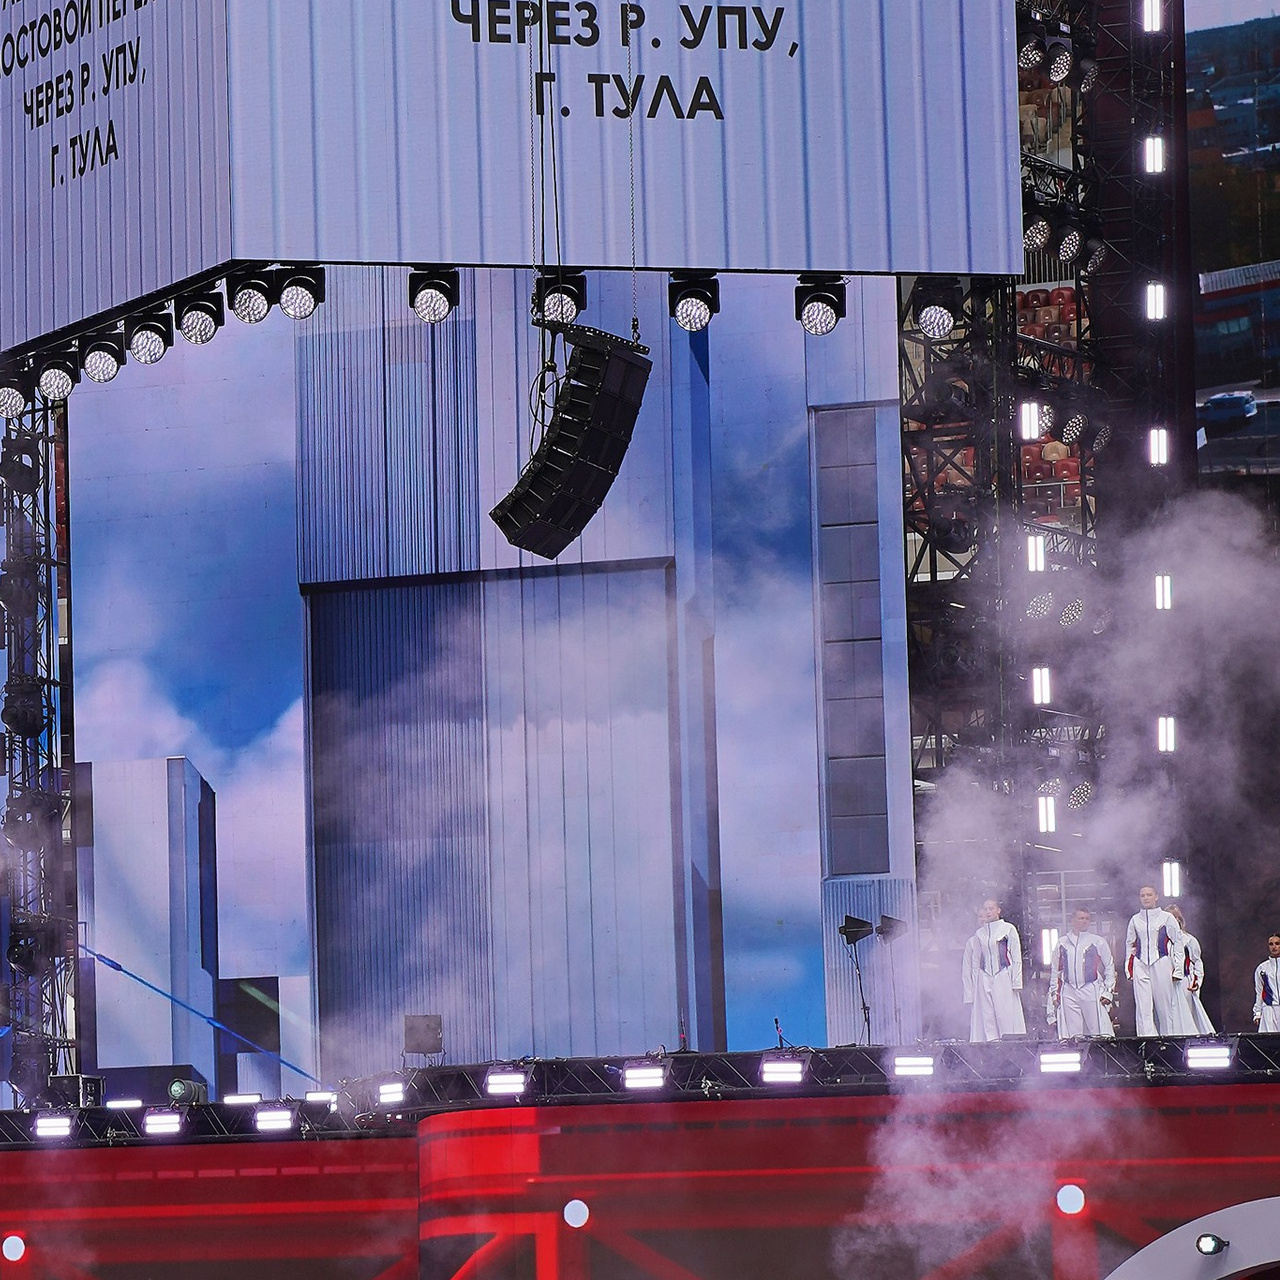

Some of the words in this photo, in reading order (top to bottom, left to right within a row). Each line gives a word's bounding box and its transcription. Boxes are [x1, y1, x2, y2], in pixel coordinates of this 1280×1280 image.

[620, 3, 661, 48] Р.
[679, 4, 799, 58] УПУ,
[24, 69, 74, 130] ЧЕРЕЗ
[81, 62, 96, 106] Р.
[102, 36, 147, 97] УПУ,
[535, 72, 571, 118] Г.
[587, 73, 725, 120] ТУЛА
[51, 145, 64, 189] Г.
[70, 119, 119, 179] ТУЛА
